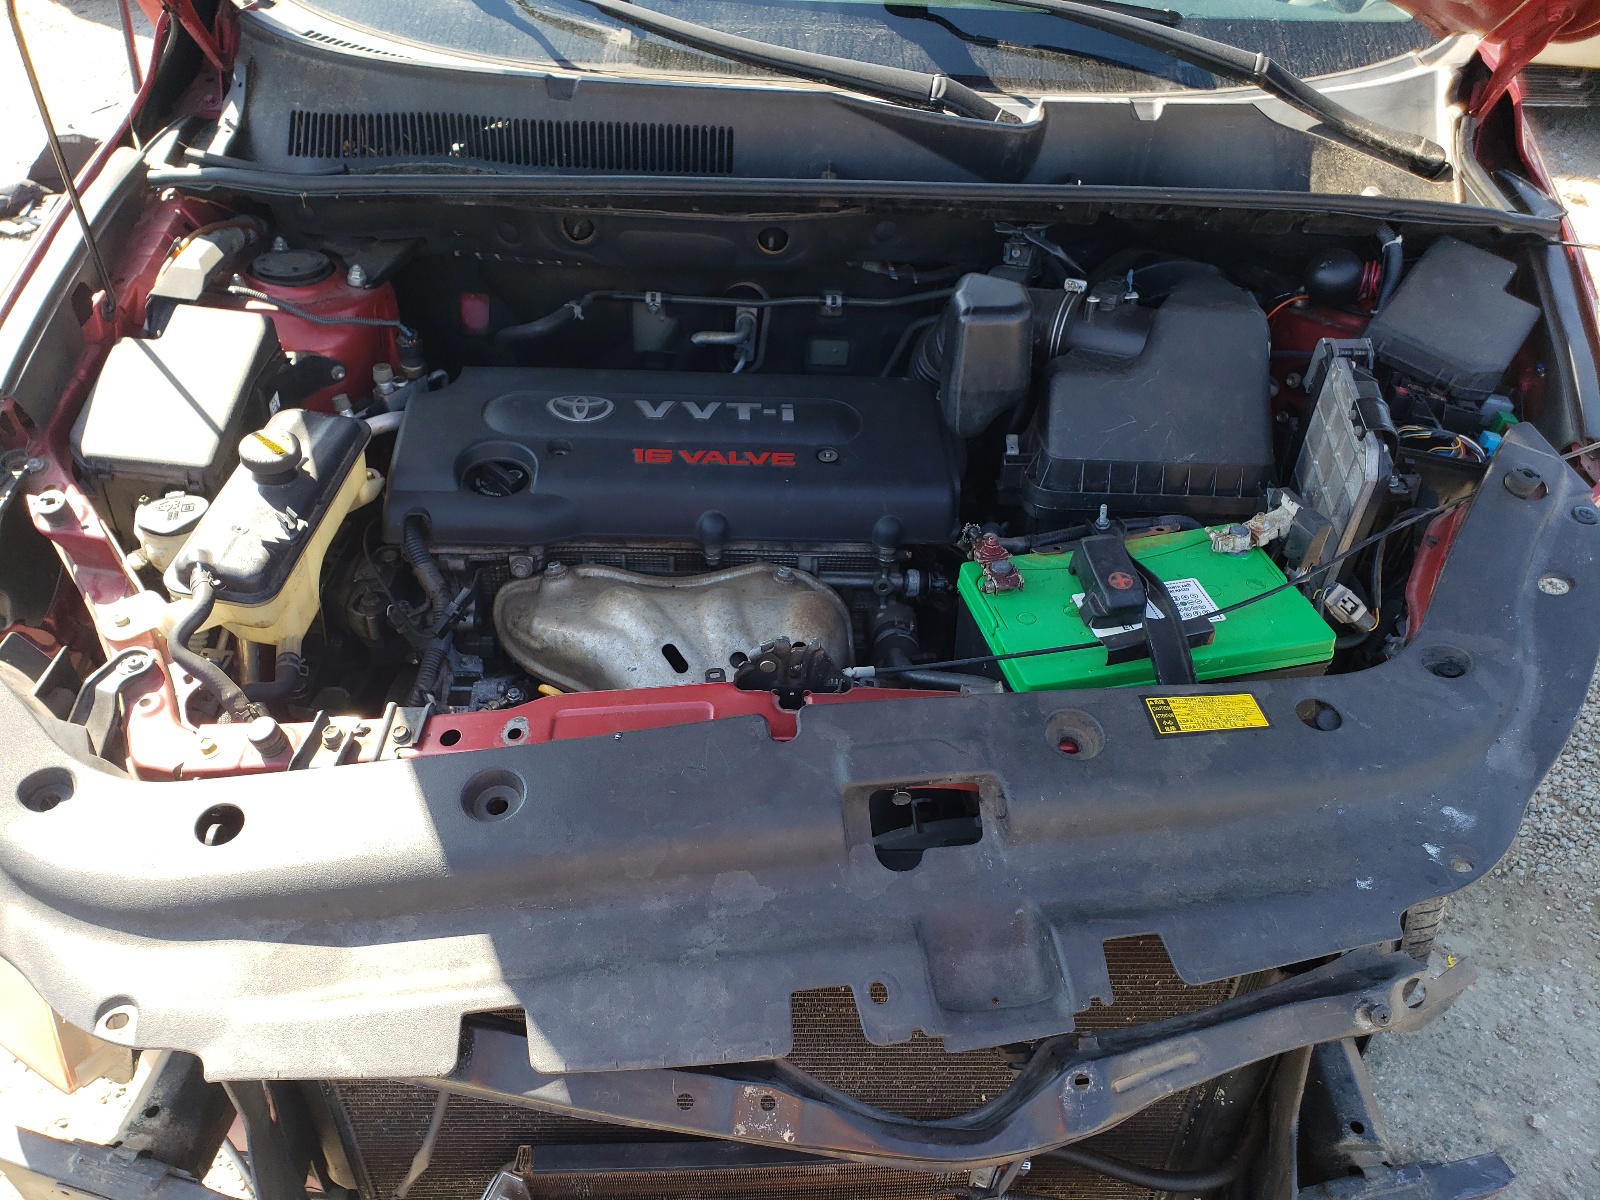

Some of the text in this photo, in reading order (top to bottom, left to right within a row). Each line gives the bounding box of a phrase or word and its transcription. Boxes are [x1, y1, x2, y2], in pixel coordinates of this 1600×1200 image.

[634, 399, 795, 422] VVT-i
[632, 447, 797, 466] 16 VALVE
